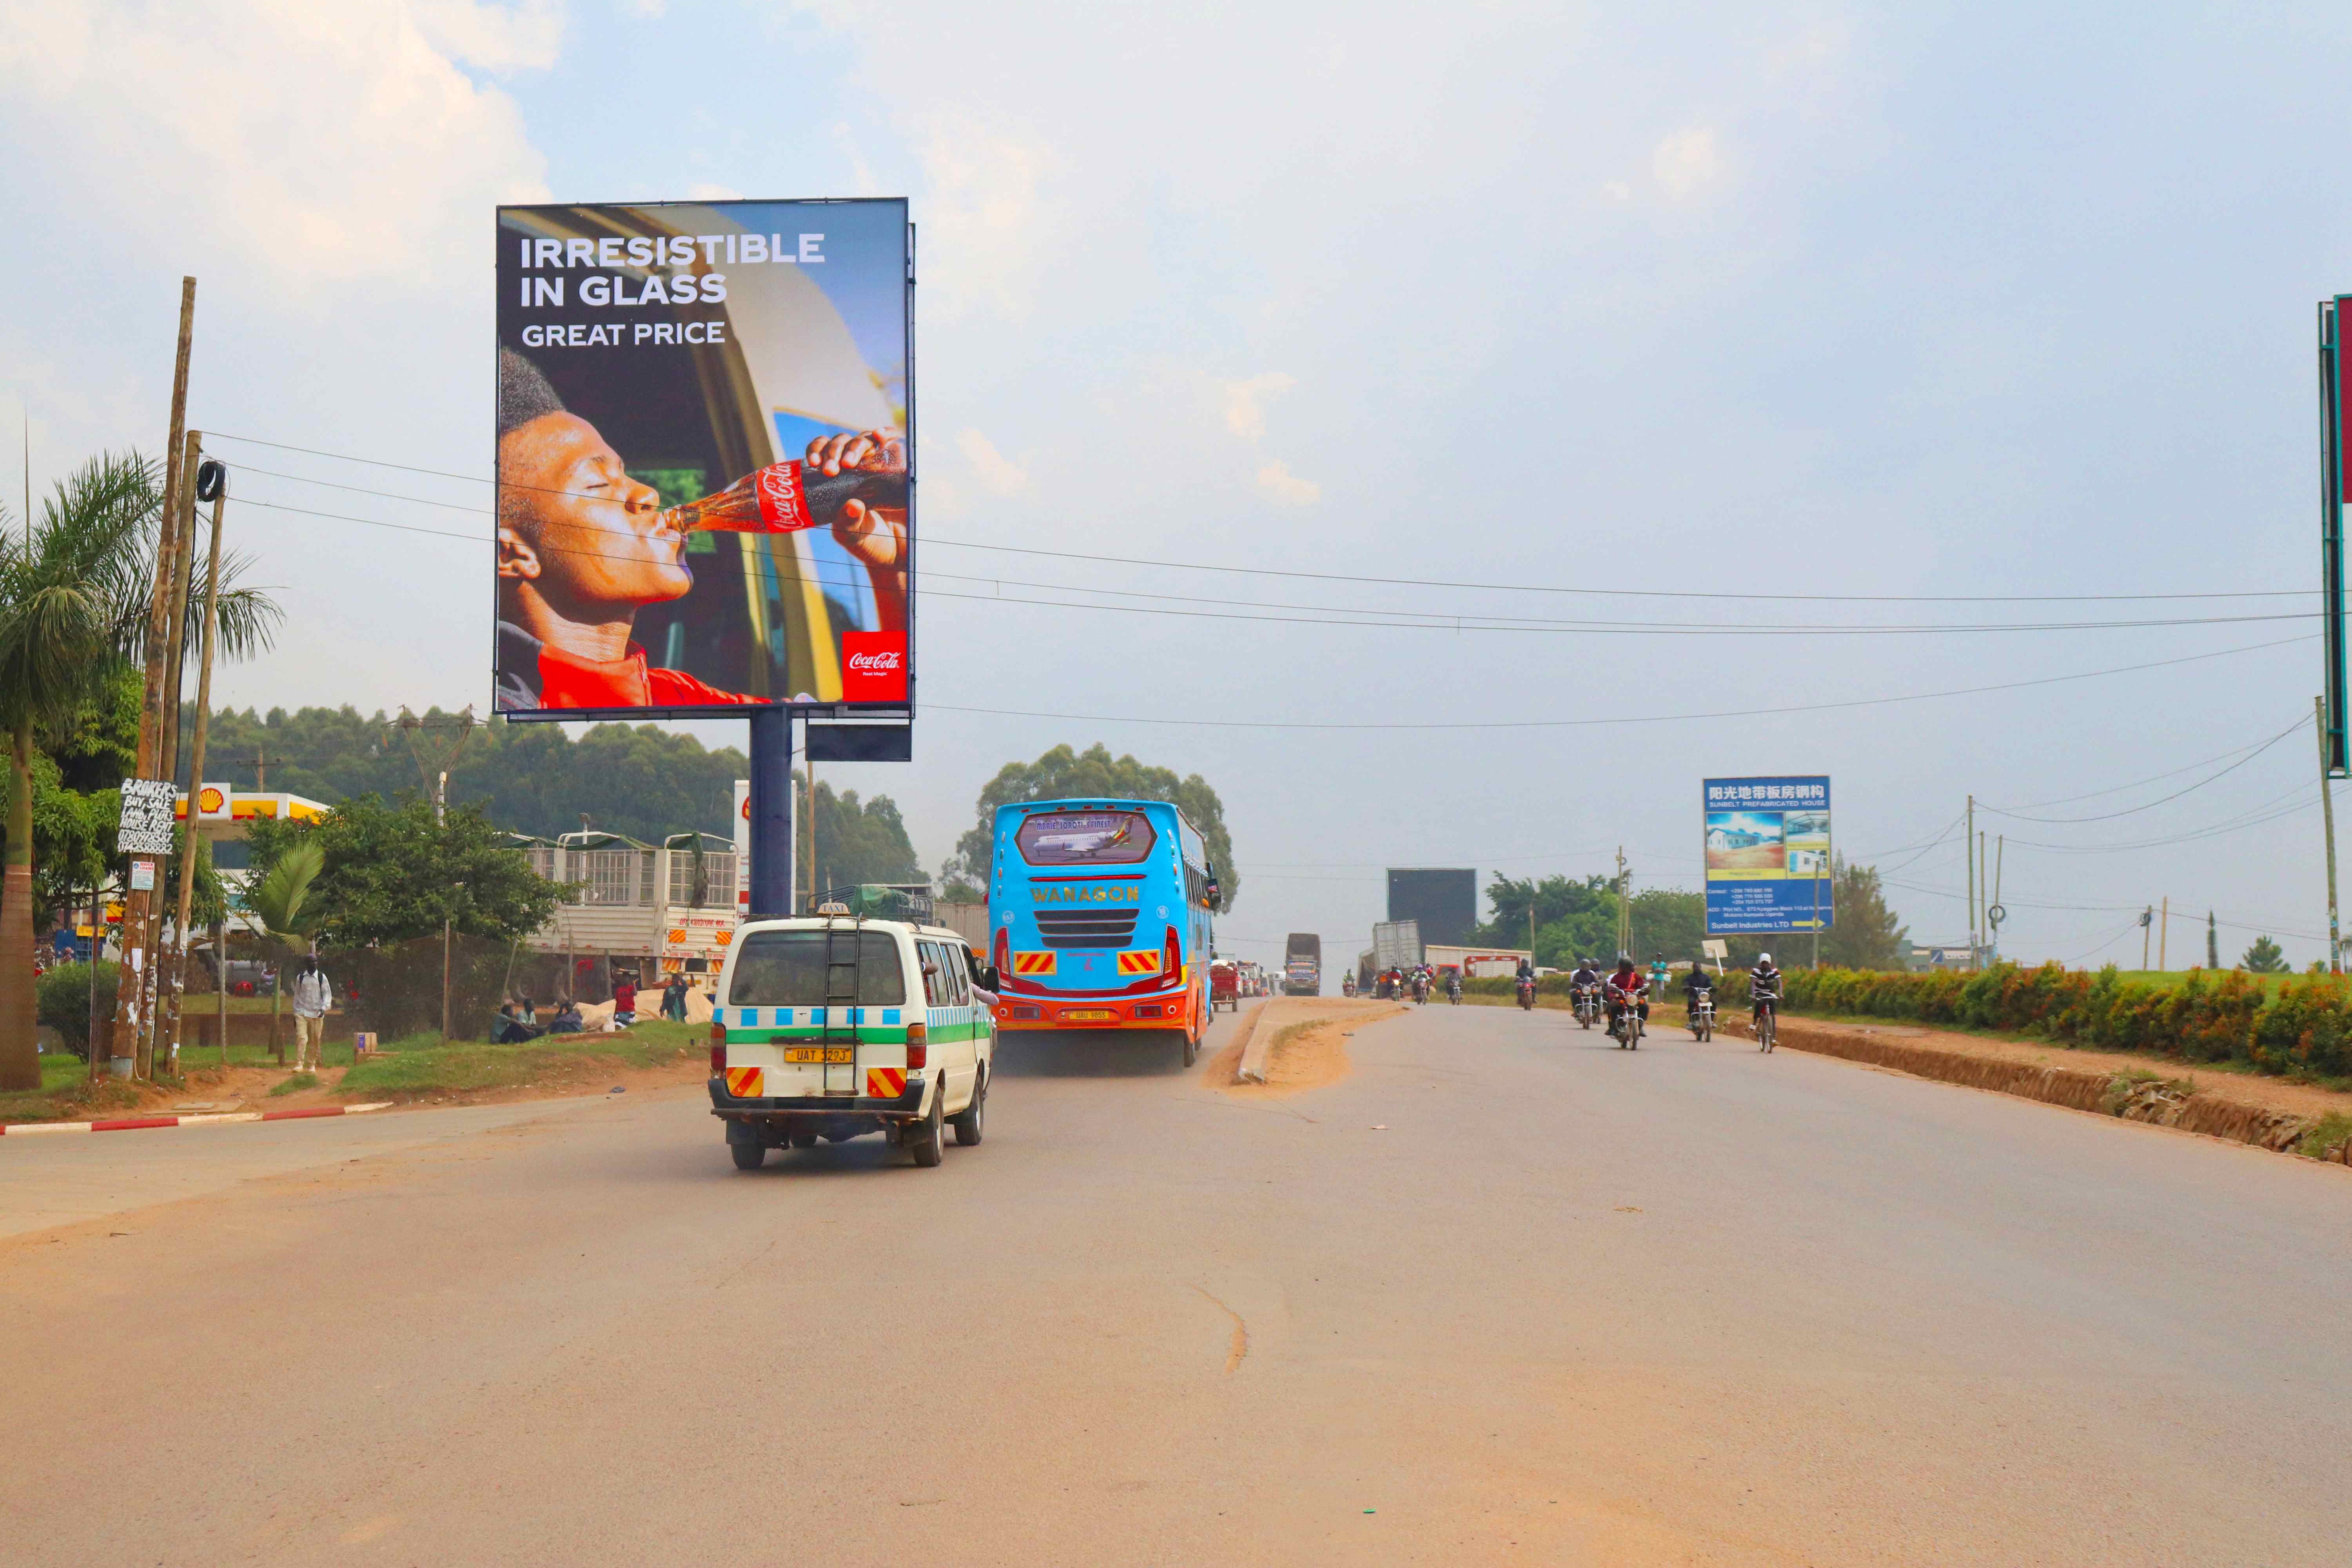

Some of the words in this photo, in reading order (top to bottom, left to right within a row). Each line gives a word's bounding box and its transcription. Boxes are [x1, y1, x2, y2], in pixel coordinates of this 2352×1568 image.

[521, 233, 826, 268] IRRESISTIBLE
[521, 276, 564, 307] IN
[579, 273, 727, 307] GLASS
[522, 324, 626, 347] GREAT
[634, 321, 726, 345] PRICE
[849, 652, 901, 669] Coca-Cola
[120, 778, 178, 800] BROKERS
[147, 797, 172, 810] SALE
[147, 808, 176, 822] PLOTS
[119, 817, 149, 831] HOUSE
[149, 819, 175, 833] RENT
[1030, 886, 1139, 903] WANAGON
[797, 1050, 816, 1060] UAT
